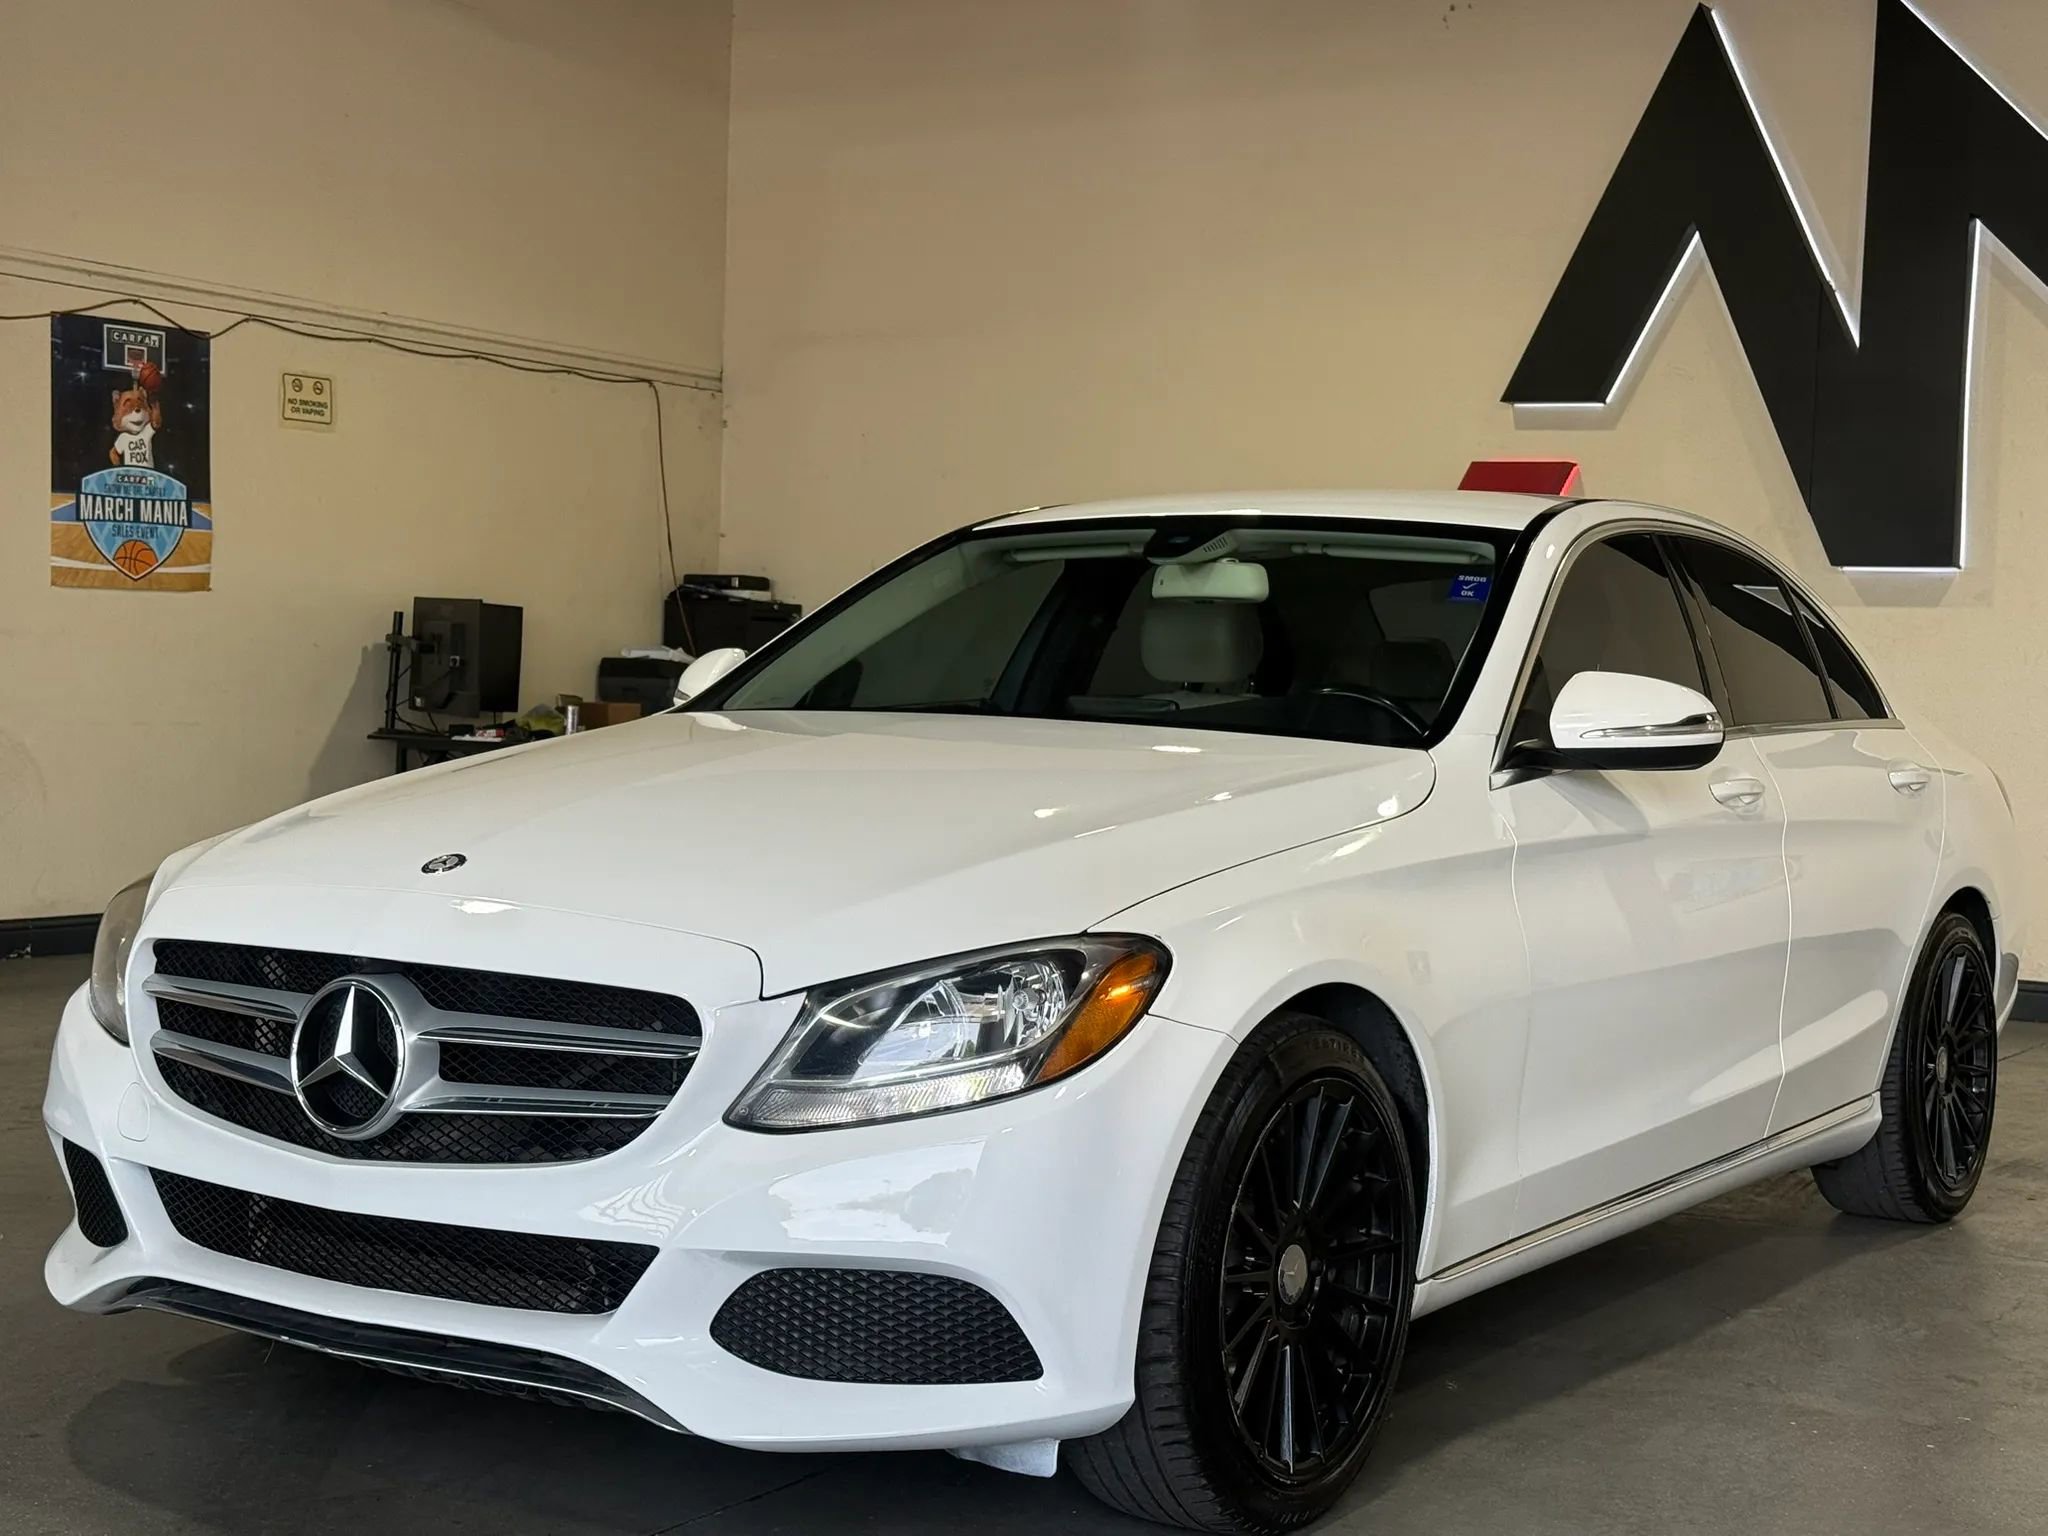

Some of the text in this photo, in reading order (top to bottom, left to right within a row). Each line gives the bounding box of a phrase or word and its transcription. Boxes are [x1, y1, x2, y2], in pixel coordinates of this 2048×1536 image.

[113, 331, 160, 348] CARFAX
[128, 438, 147, 451] CAR
[130, 451, 149, 464] FOX
[80, 494, 188, 526] MARCH MANIA
[111, 524, 160, 540] SALES EVENT
[1457, 575, 1487, 583] SMOG
